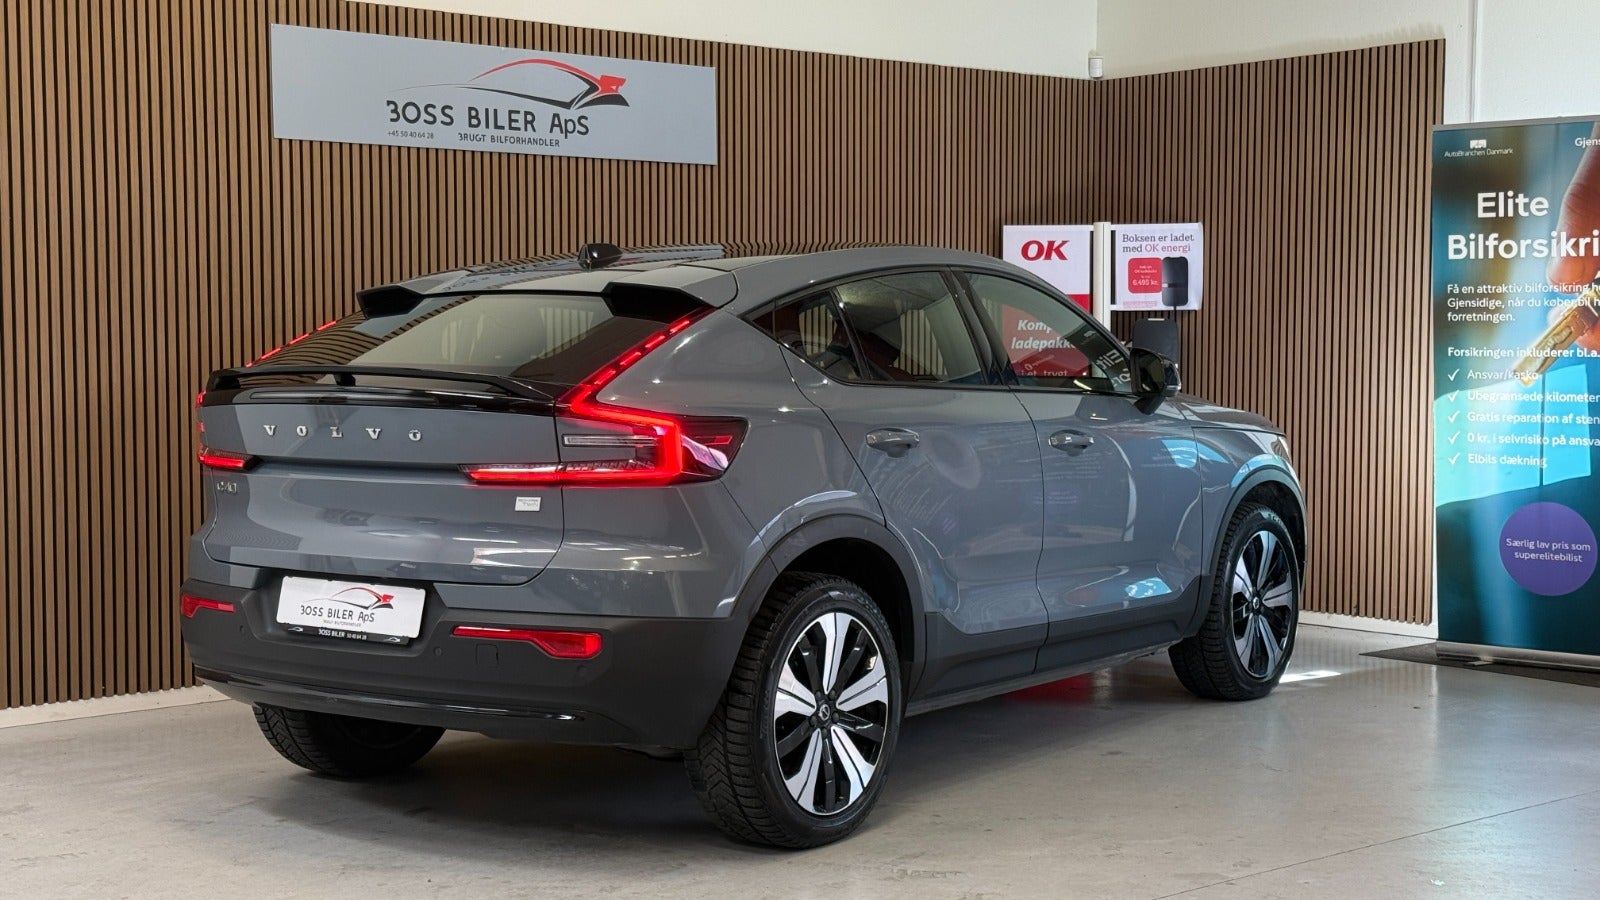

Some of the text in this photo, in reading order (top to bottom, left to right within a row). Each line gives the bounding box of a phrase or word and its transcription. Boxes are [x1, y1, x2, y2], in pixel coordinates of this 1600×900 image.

[467, 106, 536, 133] BILER
[549, 113, 590, 139] ApS
[409, 131, 417, 139] 40
[426, 132, 435, 140] 28
[490, 135, 560, 148] BILFORHANDLER
[1444, 147, 1514, 157] AutoBranchen Danmark
[1477, 190, 1549, 218] Elite
[1122, 233, 1156, 243] Boksen
[1170, 232, 1195, 242] ladet
[1021, 240, 1070, 261] OK
[1122, 243, 1191, 253] med OK energi
[1447, 283, 1459, 294] Få
[1461, 286, 1475, 294] en
[1476, 284, 1522, 294] attraktiv
[1525, 283, 1590, 294] bilforsikring
[1447, 297, 1505, 310] Gjensidige,
[1508, 298, 1524, 307] når
[1527, 298, 1541, 307] du
[1544, 297, 1576, 307] køber
[1577, 297, 1590, 306] bil
[1447, 312, 1516, 324] forretningen.
[1447, 347, 1514, 359] Forsikringen
[1516, 347, 1575, 358] inkluderer
[1467, 369, 1539, 380] Ansvar/kasko
[1467, 391, 1544, 403] Ubegrænsede
[1467, 412, 1500, 422] Gratis
[1502, 412, 1559, 424] reparation
[1561, 413, 1573, 424] af
[263, 424, 422, 441] VOLVO
[1467, 433, 1474, 442] 0
[1477, 433, 1491, 442] kr.
[1498, 434, 1550, 445] selvrisiko
[1552, 435, 1566, 447] på
[1468, 454, 1548, 468] Elbils dækning
[1506, 538, 1591, 553] Særlig lav pris som
[1514, 550, 1583, 562] superelitebilist
[327, 608, 354, 620] BILER
[358, 611, 375, 623] ApS
[331, 630, 345, 638] BILER
